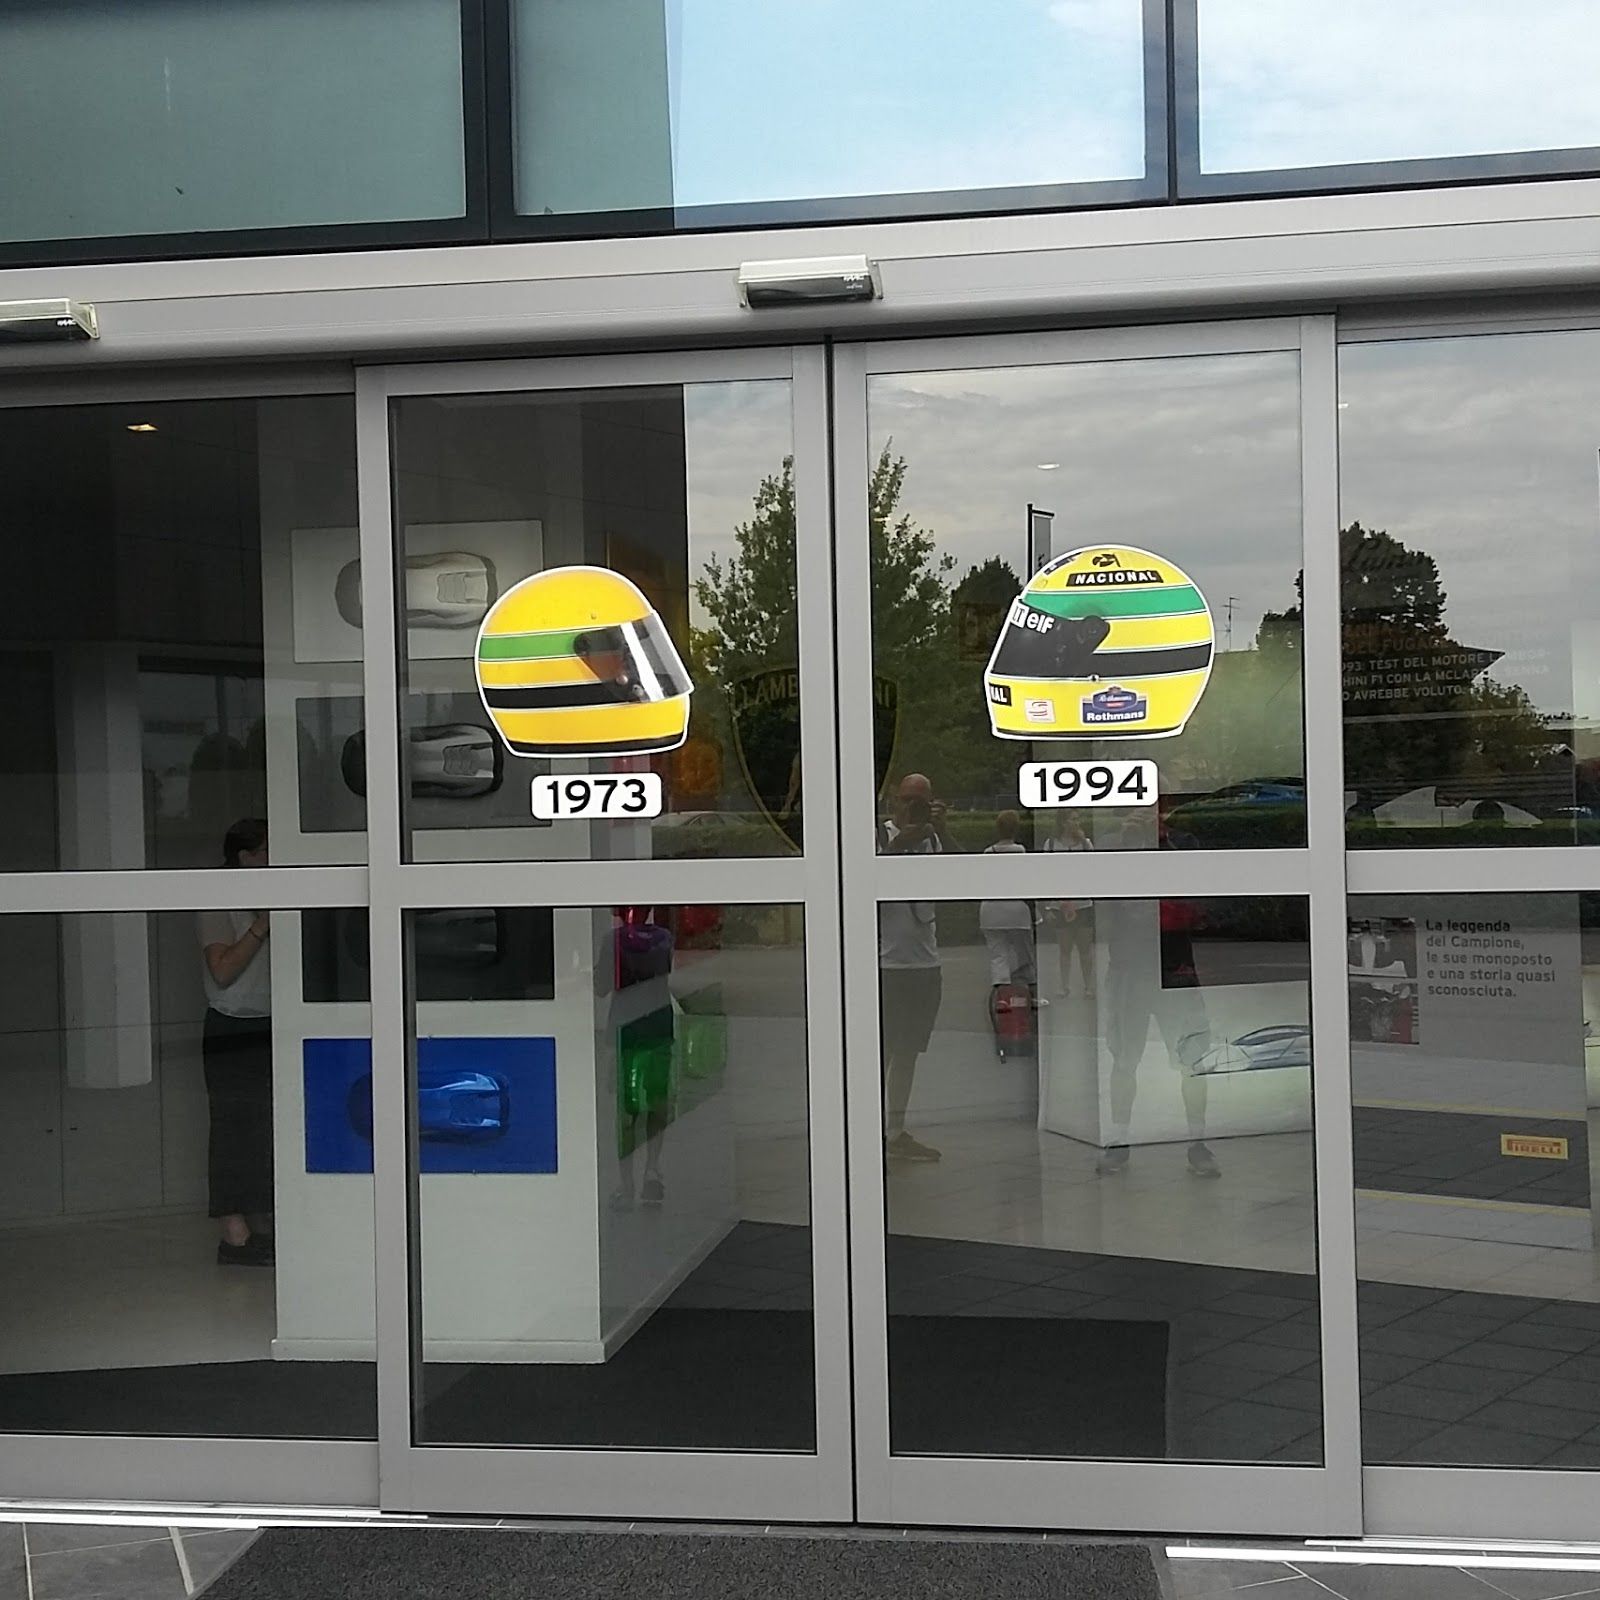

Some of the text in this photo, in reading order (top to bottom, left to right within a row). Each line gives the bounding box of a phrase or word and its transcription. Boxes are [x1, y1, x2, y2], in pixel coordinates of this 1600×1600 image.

[1075, 571, 1158, 585] NACIONAL
[1026, 612, 1055, 635] elf
[1369, 659, 1400, 670] TEST
[1404, 657, 1428, 668] DEL
[1432, 653, 1484, 667] MOTORE
[1386, 673, 1412, 684] CON
[1416, 671, 1432, 682] LA
[1354, 687, 1410, 701] AVREBBE
[1086, 709, 1145, 722] Rothmans
[1034, 766, 1148, 802] 1994
[546, 778, 648, 814] 1973
[1425, 919, 1511, 934] La leggenda
[1426, 935, 1525, 951] del Campione,
[1426, 951, 1553, 967] le sue monoposto
[1427, 968, 1556, 984] e una storia quasi
[1428, 984, 1517, 998] sconosciuta.
[1507, 1139, 1563, 1155] PIRELLI
